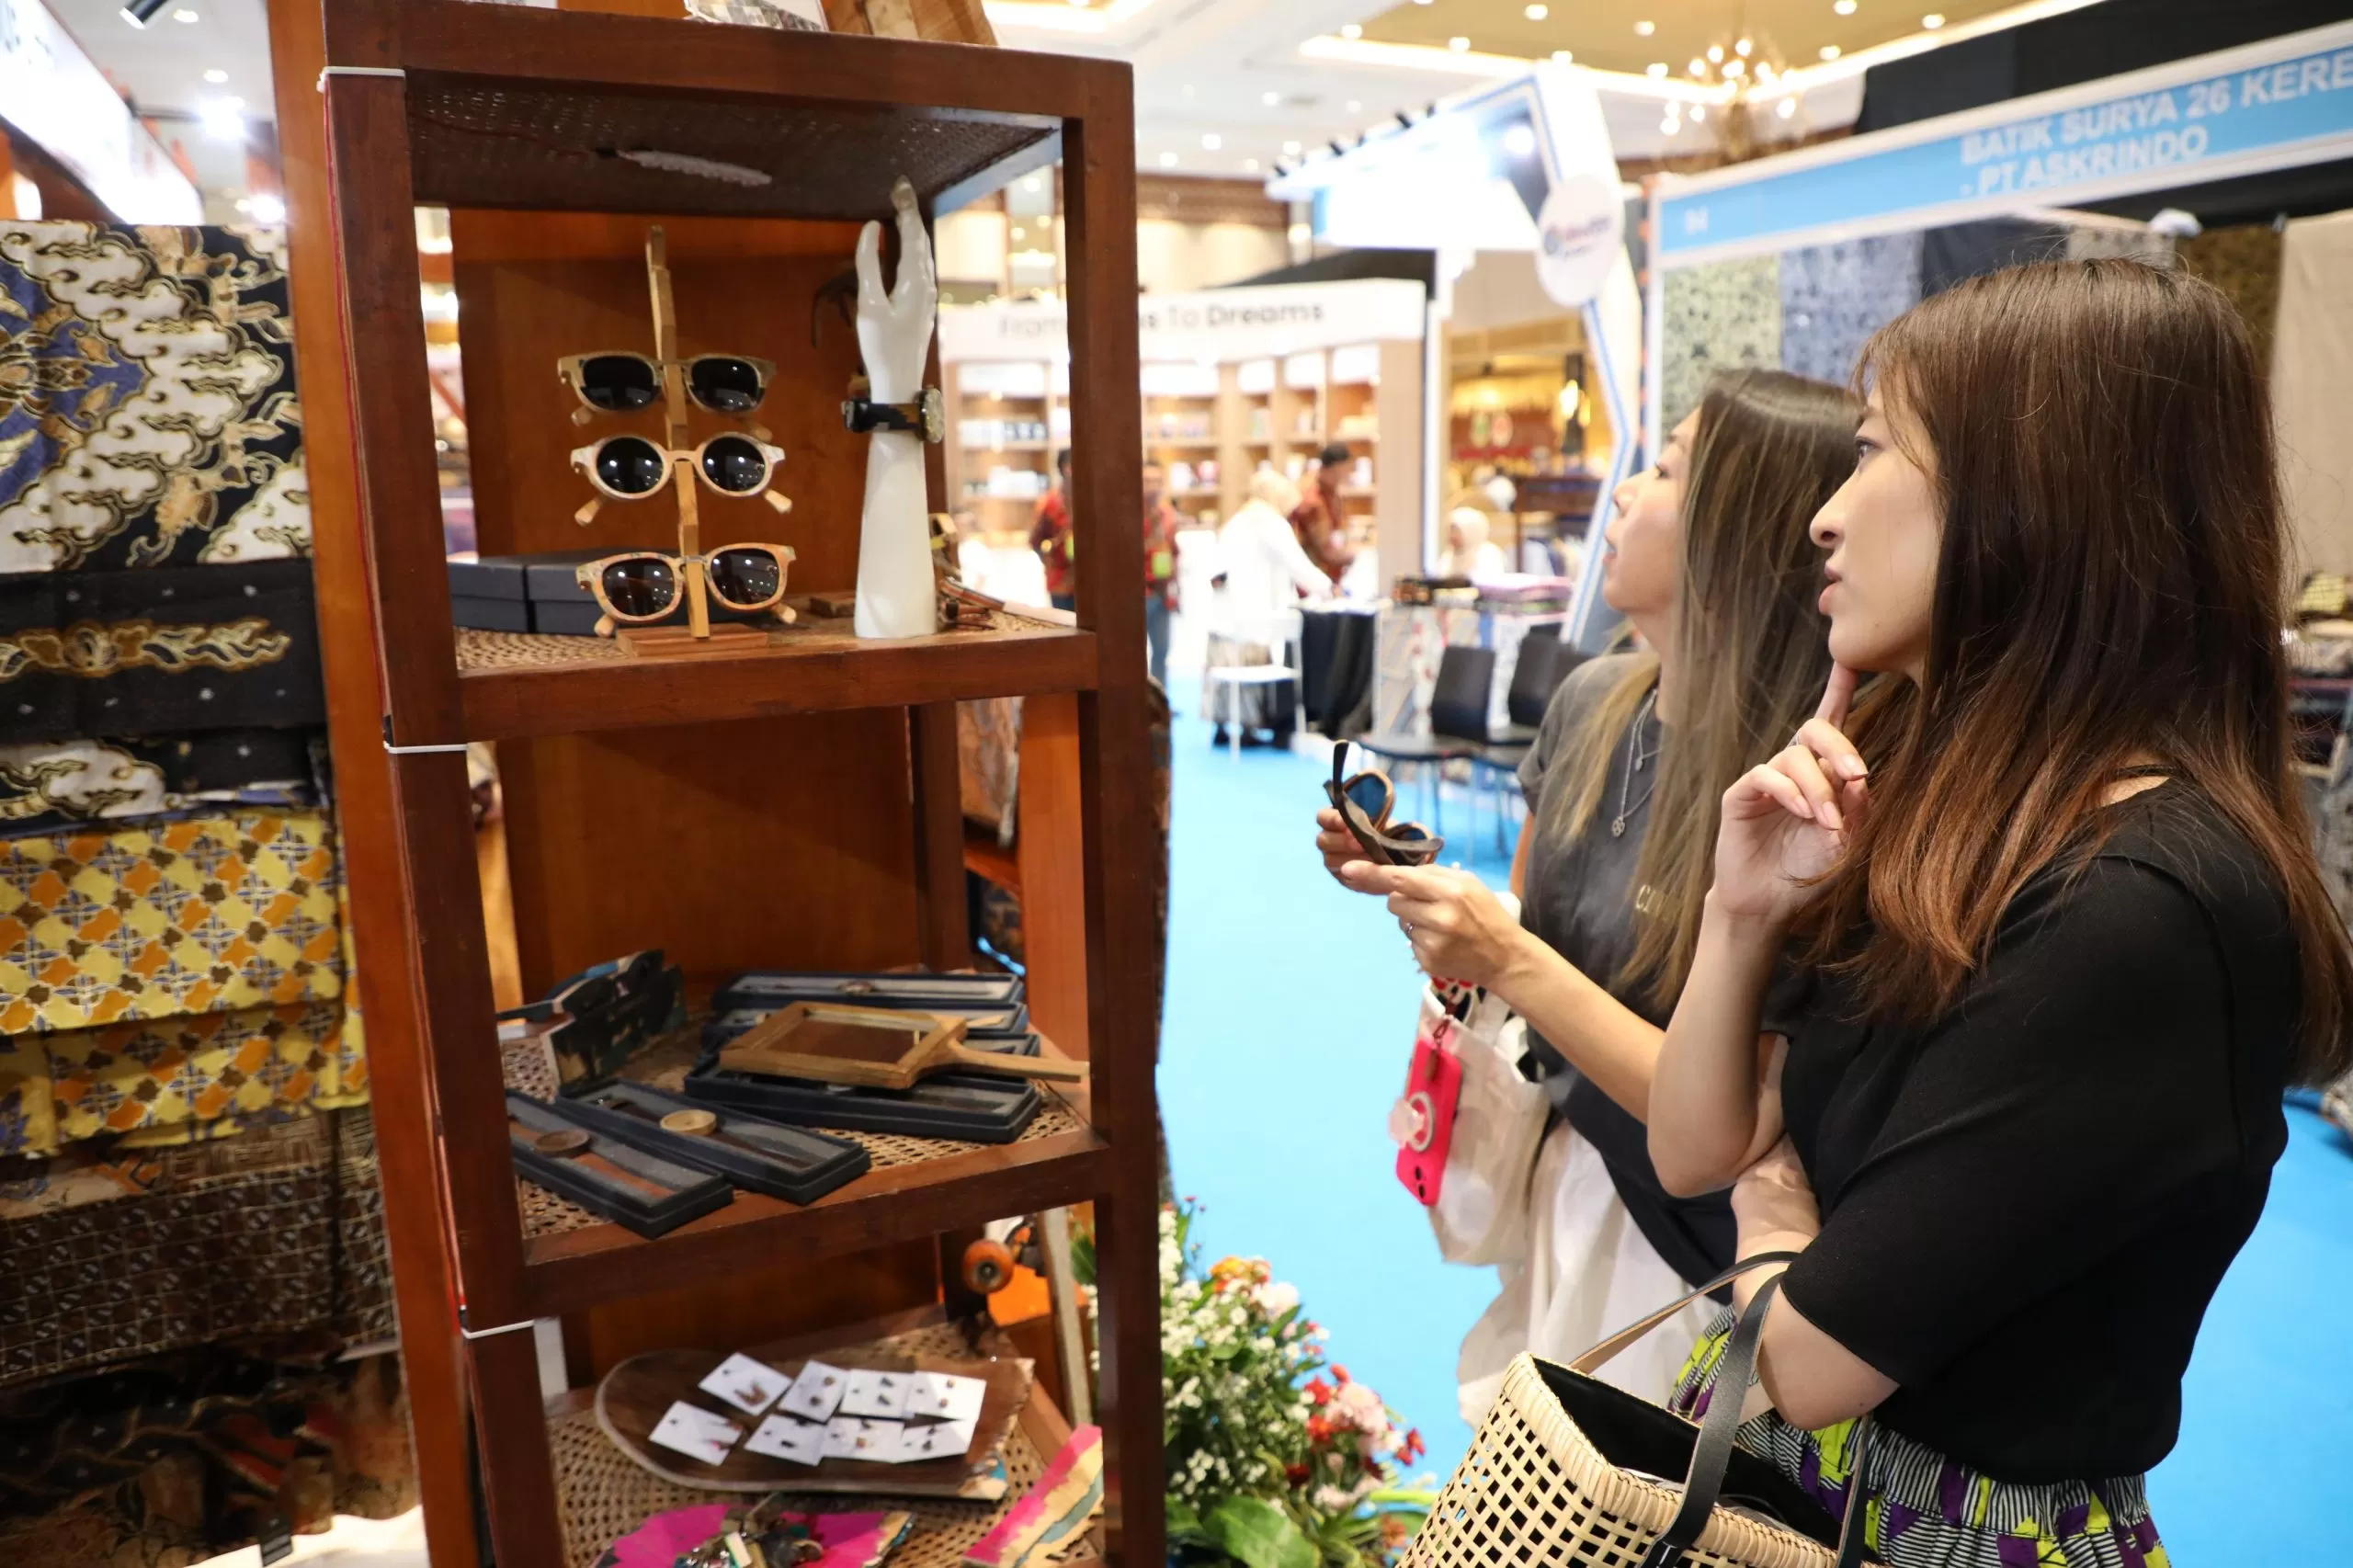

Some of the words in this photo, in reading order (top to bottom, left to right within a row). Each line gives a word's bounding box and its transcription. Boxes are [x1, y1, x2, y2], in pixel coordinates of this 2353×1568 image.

[1961, 119, 2053, 165] BATIK
[2062, 91, 2177, 145] SURYA
[2186, 78, 2231, 119] 26
[2022, 125, 2209, 190] ASKRINDO
[1166, 304, 1199, 328] To
[1205, 301, 1325, 328] Dreams
